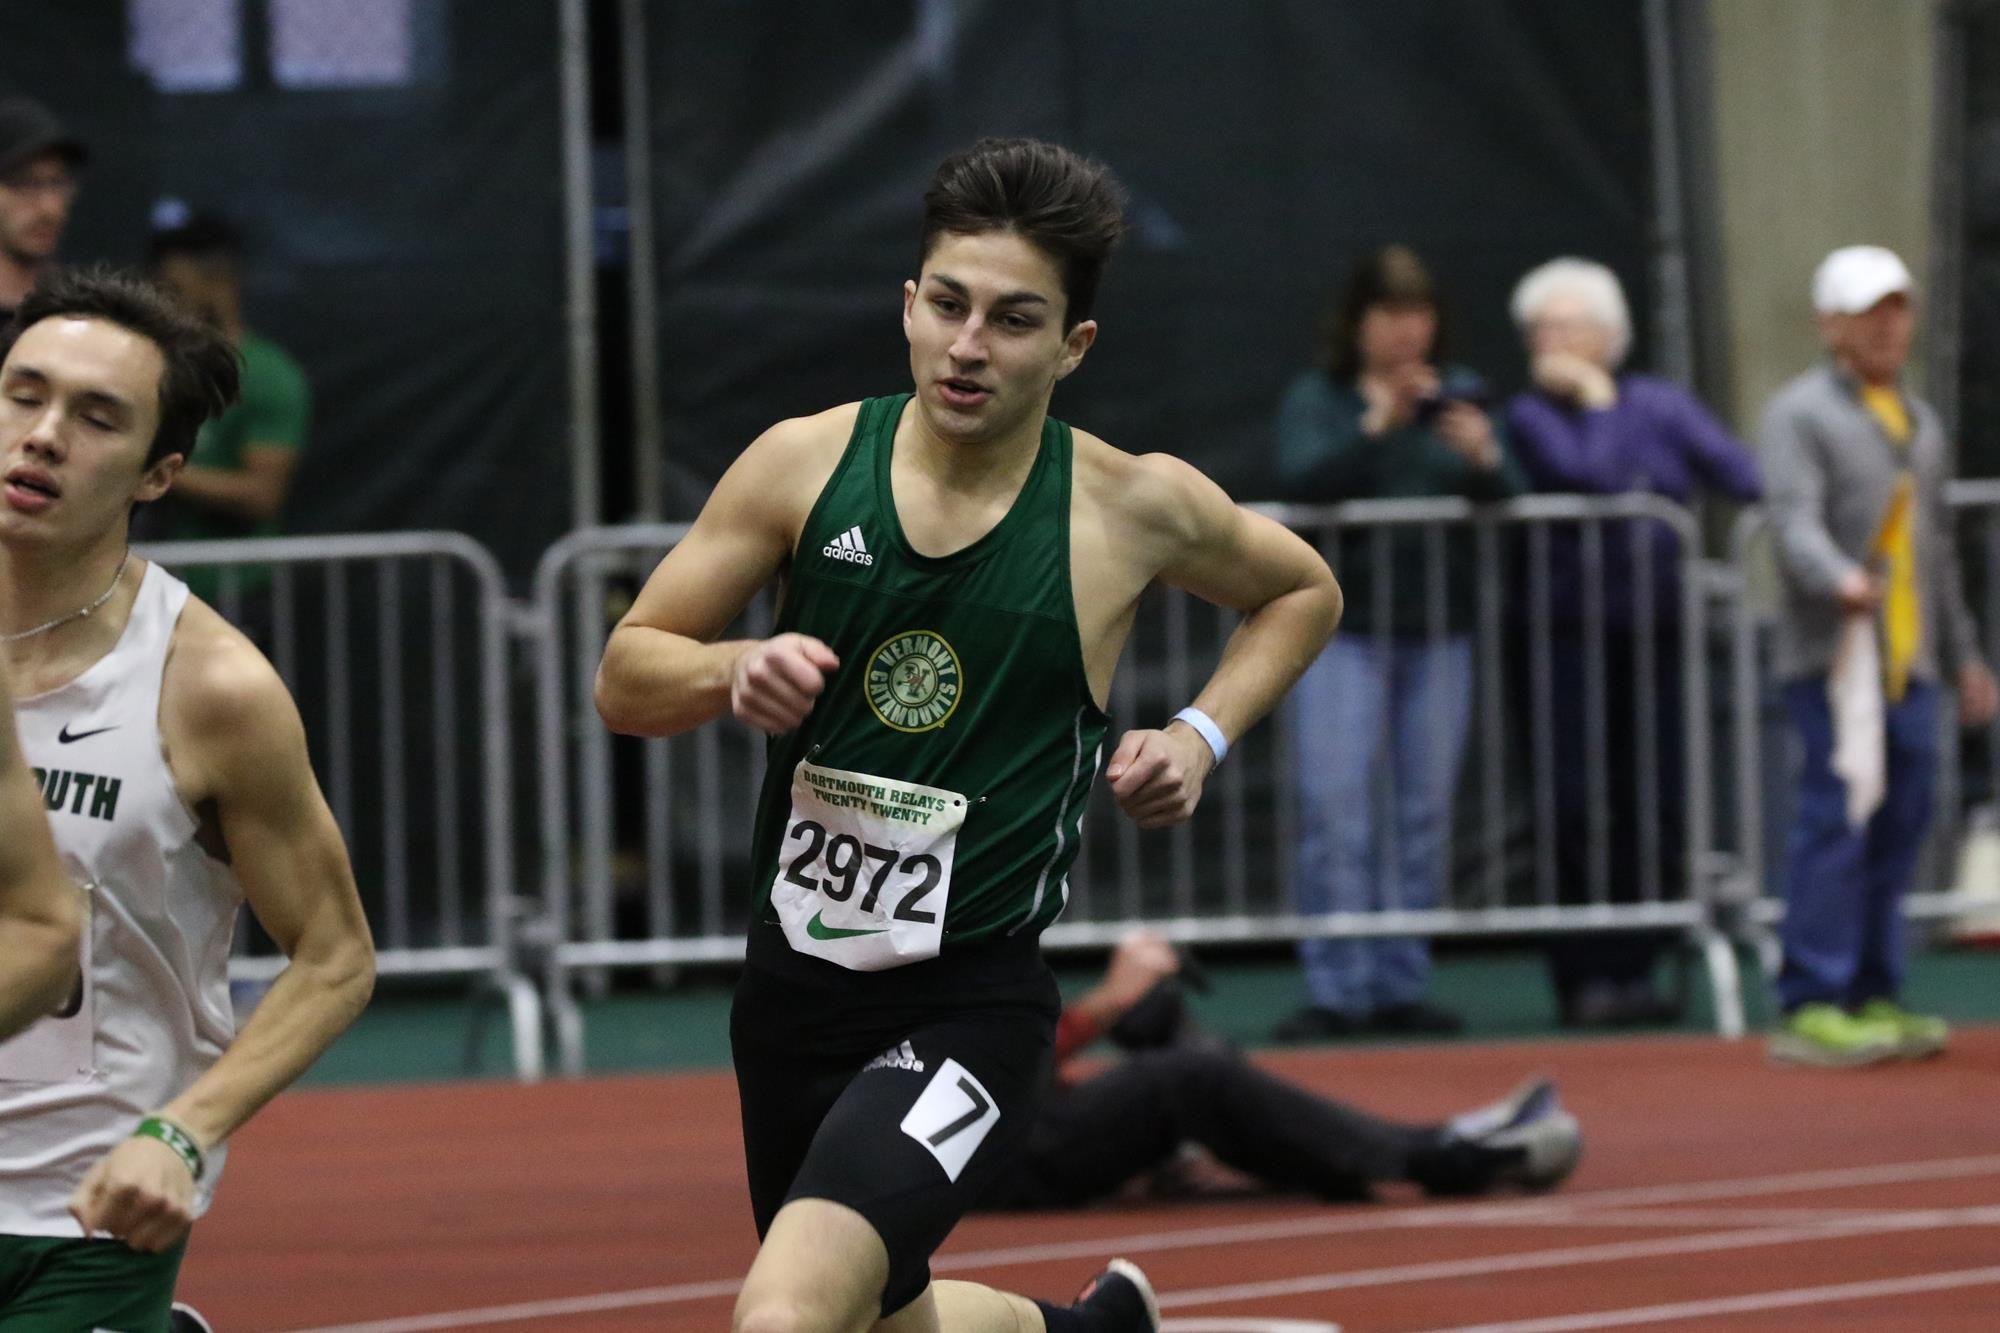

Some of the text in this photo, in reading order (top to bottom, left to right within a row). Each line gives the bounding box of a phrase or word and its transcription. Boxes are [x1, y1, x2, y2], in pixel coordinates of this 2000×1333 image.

[823, 544, 873, 566] adidas
[879, 635, 956, 676] VERMONT
[870, 670, 956, 727] CATAMOUNTS
[804, 770, 946, 812] DARTMOUTH RELAYS
[813, 788, 931, 825] TWENTY TWENTY
[783, 820, 942, 924] 2972
[925, 1076, 990, 1148] 7
